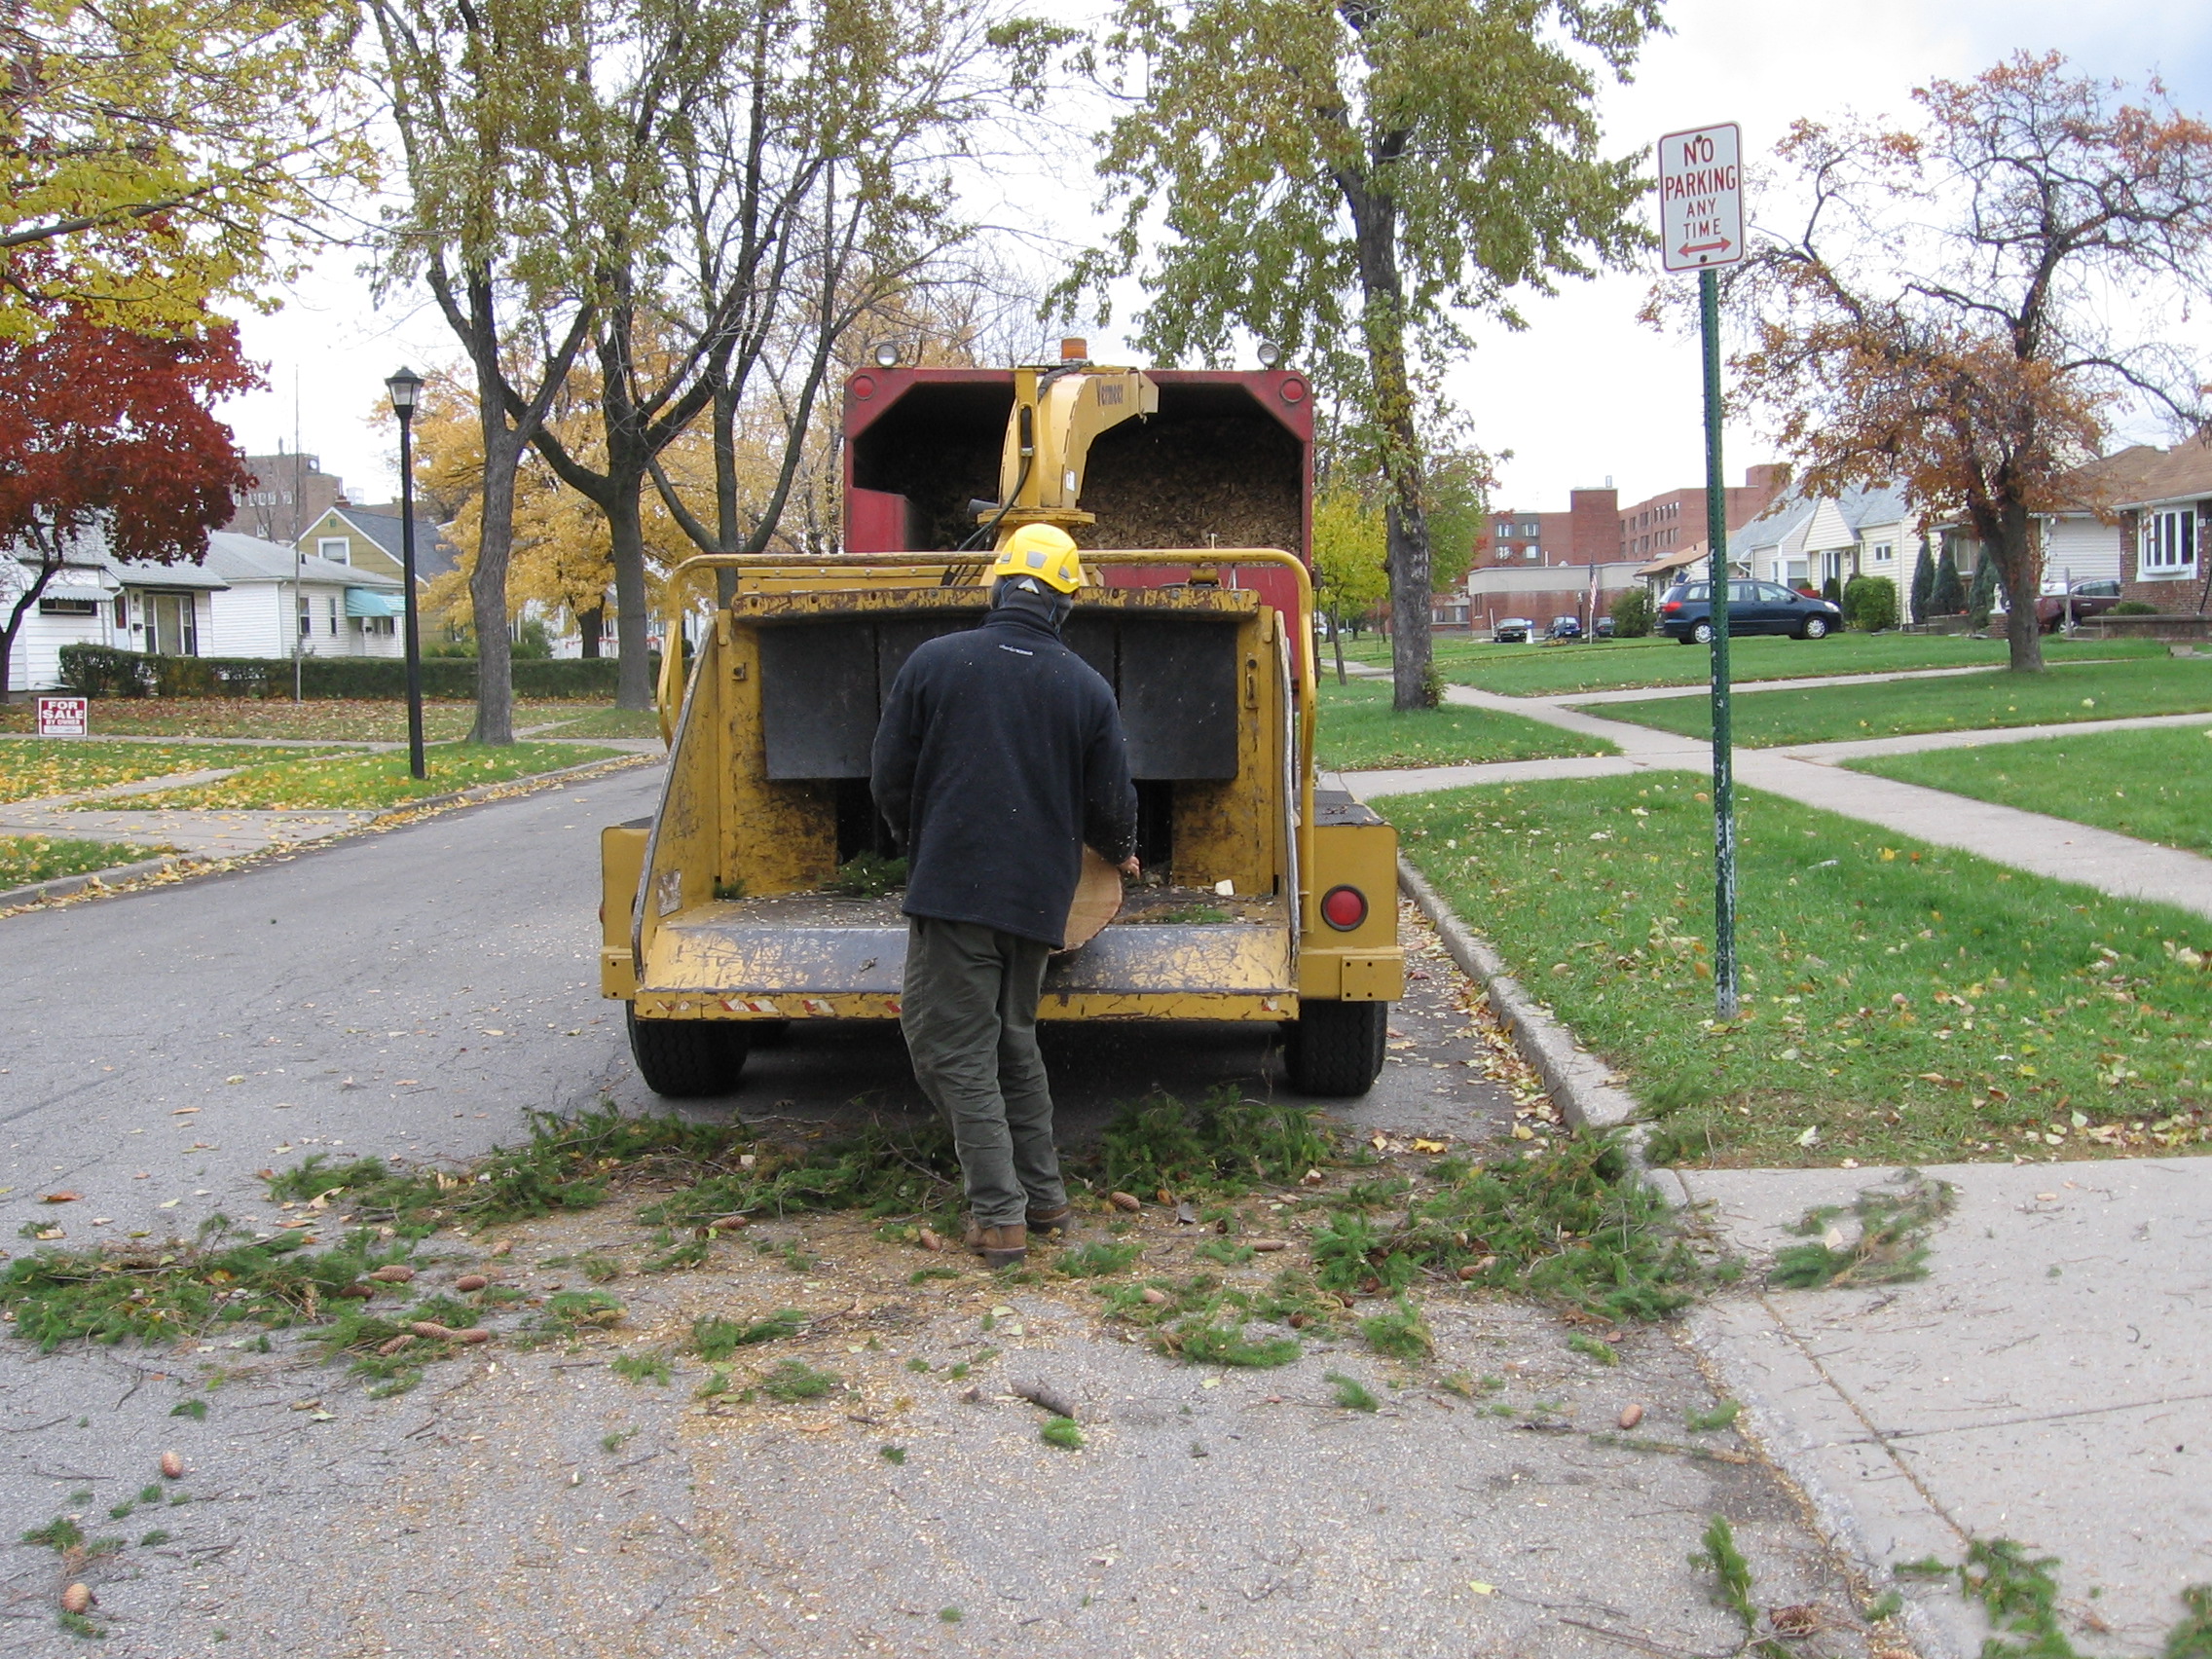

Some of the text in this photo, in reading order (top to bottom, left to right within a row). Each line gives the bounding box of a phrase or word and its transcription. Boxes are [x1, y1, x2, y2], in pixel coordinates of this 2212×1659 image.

[1683, 137, 1714, 166] NO
[1666, 165, 1736, 202] PARKING
[1686, 198, 1716, 218] ANY
[1683, 218, 1721, 240] TIME
[42, 710, 84, 719] SALE
[48, 701, 78, 710] FOR
